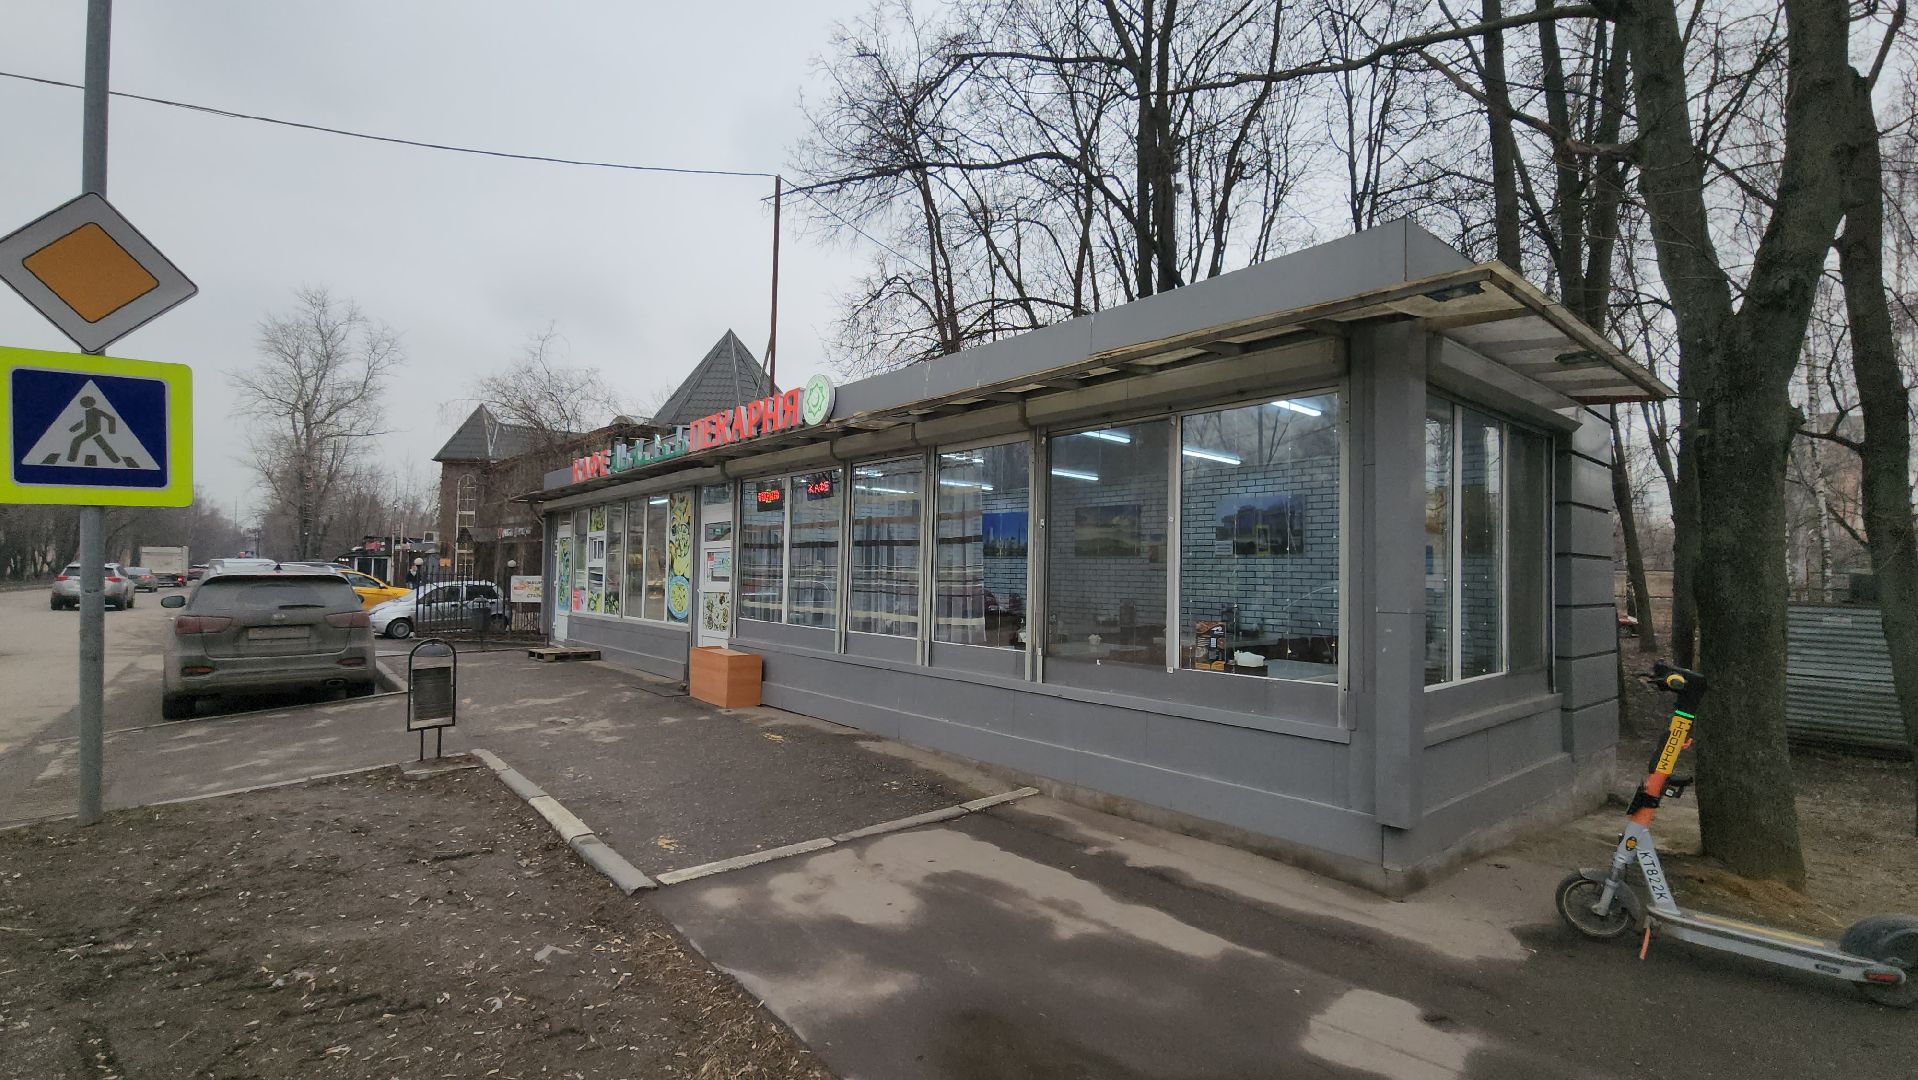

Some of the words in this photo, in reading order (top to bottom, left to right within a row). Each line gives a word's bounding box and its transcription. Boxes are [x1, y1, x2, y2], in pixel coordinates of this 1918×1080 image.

[689, 387, 803, 452] ПЕКАРНЯ
[572, 448, 611, 484] КАФЕ
[1658, 720, 1685, 771] WHOOSH
[1638, 851, 1669, 901] KT822K
